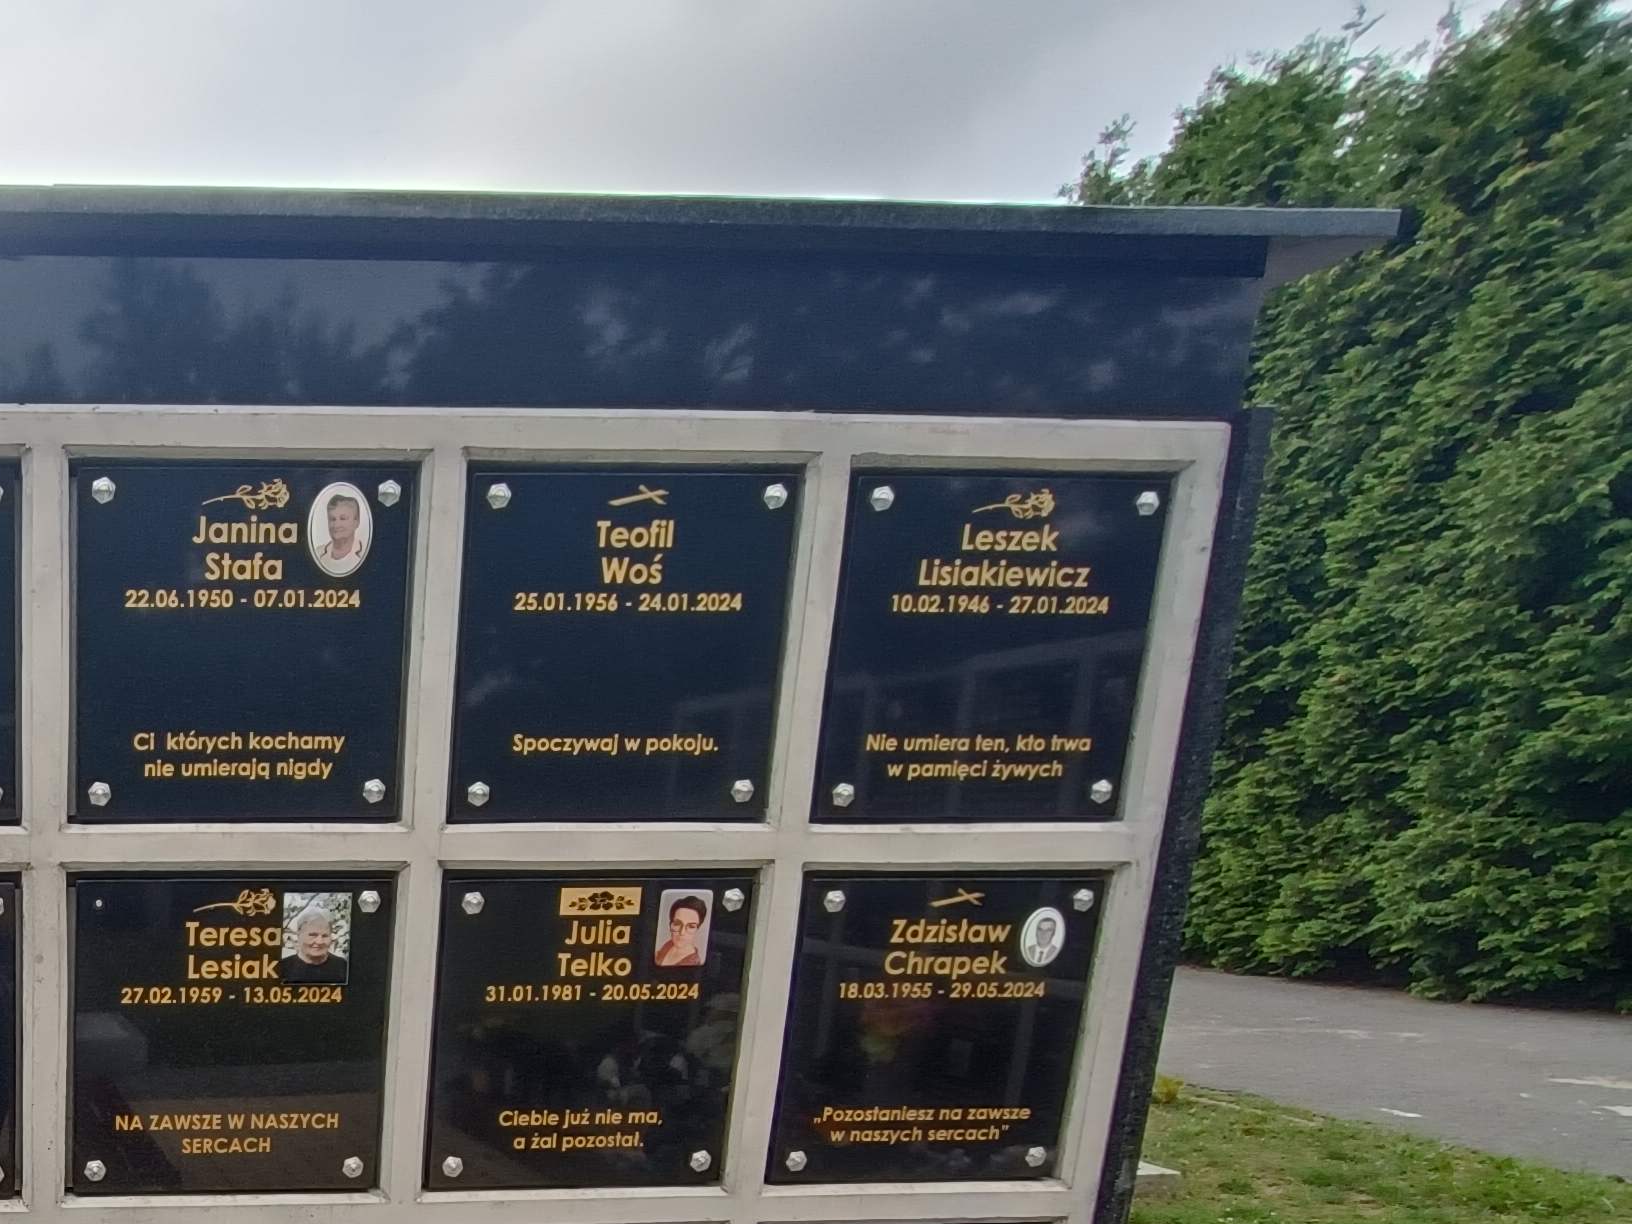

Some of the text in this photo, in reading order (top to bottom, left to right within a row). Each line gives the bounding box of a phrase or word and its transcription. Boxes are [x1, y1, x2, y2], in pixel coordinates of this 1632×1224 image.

[191, 514, 298, 544] Janina
[596, 519, 675, 549] Teofil
[961, 523, 1060, 552] Leszek
[204, 551, 283, 581] Stafa
[601, 553, 663, 585] Woś
[918, 558, 1091, 588] Lisiakiewicz
[124, 589, 361, 609] 22.06.1950 07.01.2024
[513, 592, 742, 612] 25.01.1956 24.01.2024
[892, 594, 1109, 615] 10.02.1946 27.01.2024
[133, 730, 346, 755] Ci których kochamy
[512, 733, 719, 756] Spoczywaj pokoju.
[865, 733, 1092, 753] Nie umiera ten, kto trwa
[144, 757, 333, 781] nie umierają nigdy
[907, 759, 1063, 781] pamięci żywych
[185, 921, 284, 952] Teresa
[564, 919, 631, 945] Julia
[889, 918, 1012, 944] Zdzisław
[187, 953, 279, 980] Lesiak
[557, 951, 632, 977] Telko
[884, 950, 1008, 981] Chrapek
[120, 983, 343, 1004] 27.02.1959 13.05.2024
[485, 983, 699, 1002] 31.01.1981 20.05.2024
[839, 981, 1045, 999] 18.03.1955 29.05.2024
[115, 1112, 339, 1131] NA ZAWSZE W NASZYCH
[498, 1108, 663, 1129] Ciebie już nie ma,
[938, 1108, 963, 1121] na
[966, 1107, 1031, 1121] zawsze
[181, 1136, 271, 1154] SERCACH
[530, 1131, 644, 1152] żal pozostał.
[849, 1126, 923, 1145] naszych
